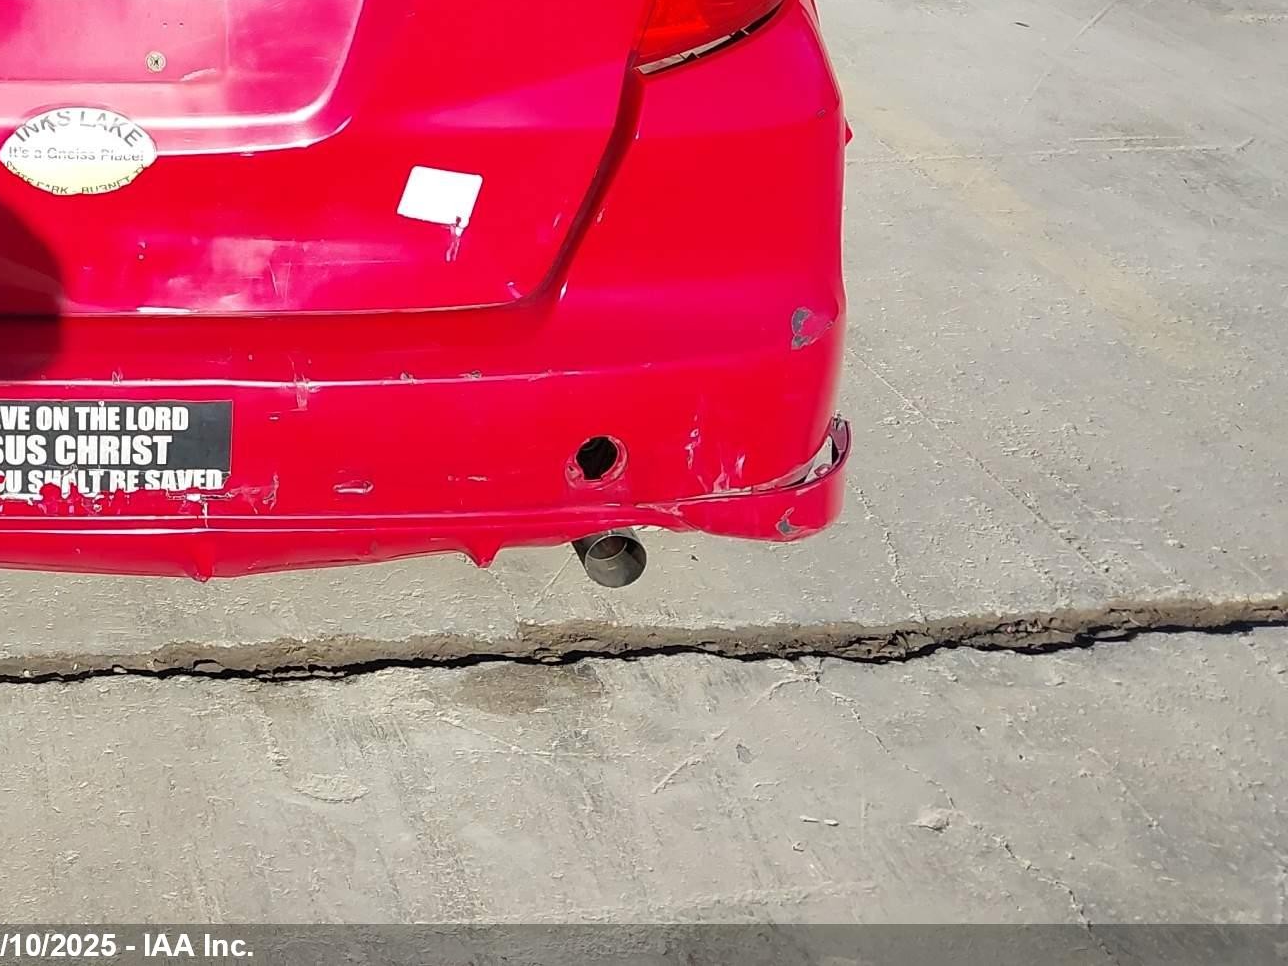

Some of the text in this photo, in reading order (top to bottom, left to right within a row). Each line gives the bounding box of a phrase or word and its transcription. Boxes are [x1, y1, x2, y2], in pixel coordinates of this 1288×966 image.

[15, 111, 142, 147] INKS LAKE
[36, 406, 70, 430] ON
[75, 406, 120, 431] THE
[125, 406, 189, 431] LORD
[54, 434, 172, 466] CHRIST
[145, 469, 223, 491] SAVED
